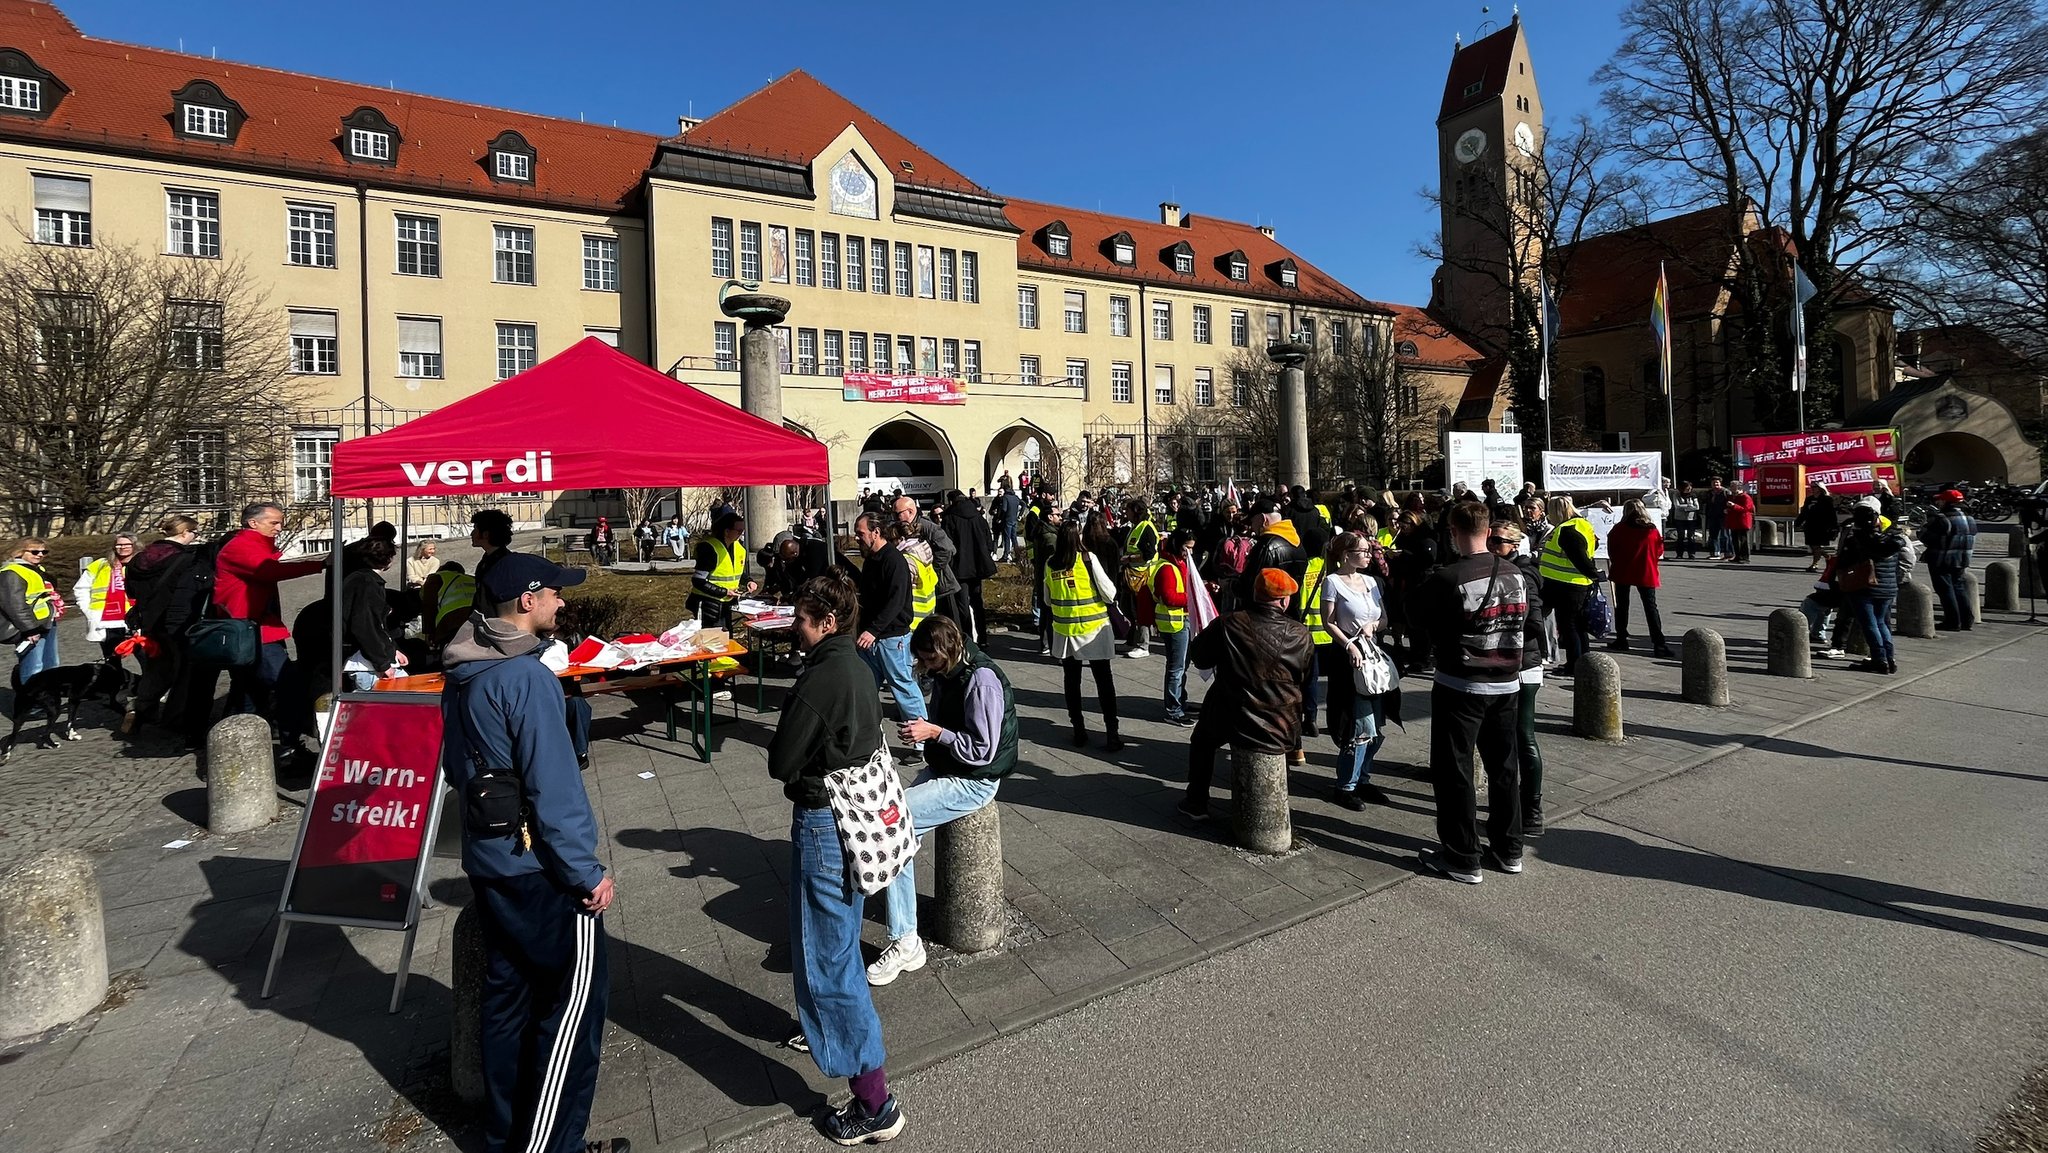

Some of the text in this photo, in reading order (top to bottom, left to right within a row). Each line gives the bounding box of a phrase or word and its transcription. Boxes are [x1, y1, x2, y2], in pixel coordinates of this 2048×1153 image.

[868, 389, 886, 399] MEHR
[886, 387, 903, 397] ZEIT
[908, 386, 928, 395] MEINE
[1782, 435, 1832, 449] MEHR GELD,
[1753, 452, 1775, 463] MEHR
[1776, 449, 1798, 460] ZEIT
[1806, 444, 1836, 455] MEINE
[400, 451, 553, 487] ver.di
[1549, 463, 1585, 475] Solidarisch
[1584, 466, 1594, 475] an
[1593, 464, 1611, 475] Eurer
[1840, 469, 1873, 482] MEHR
[343, 759, 425, 788] Warn-
[331, 800, 420, 828] streik!
